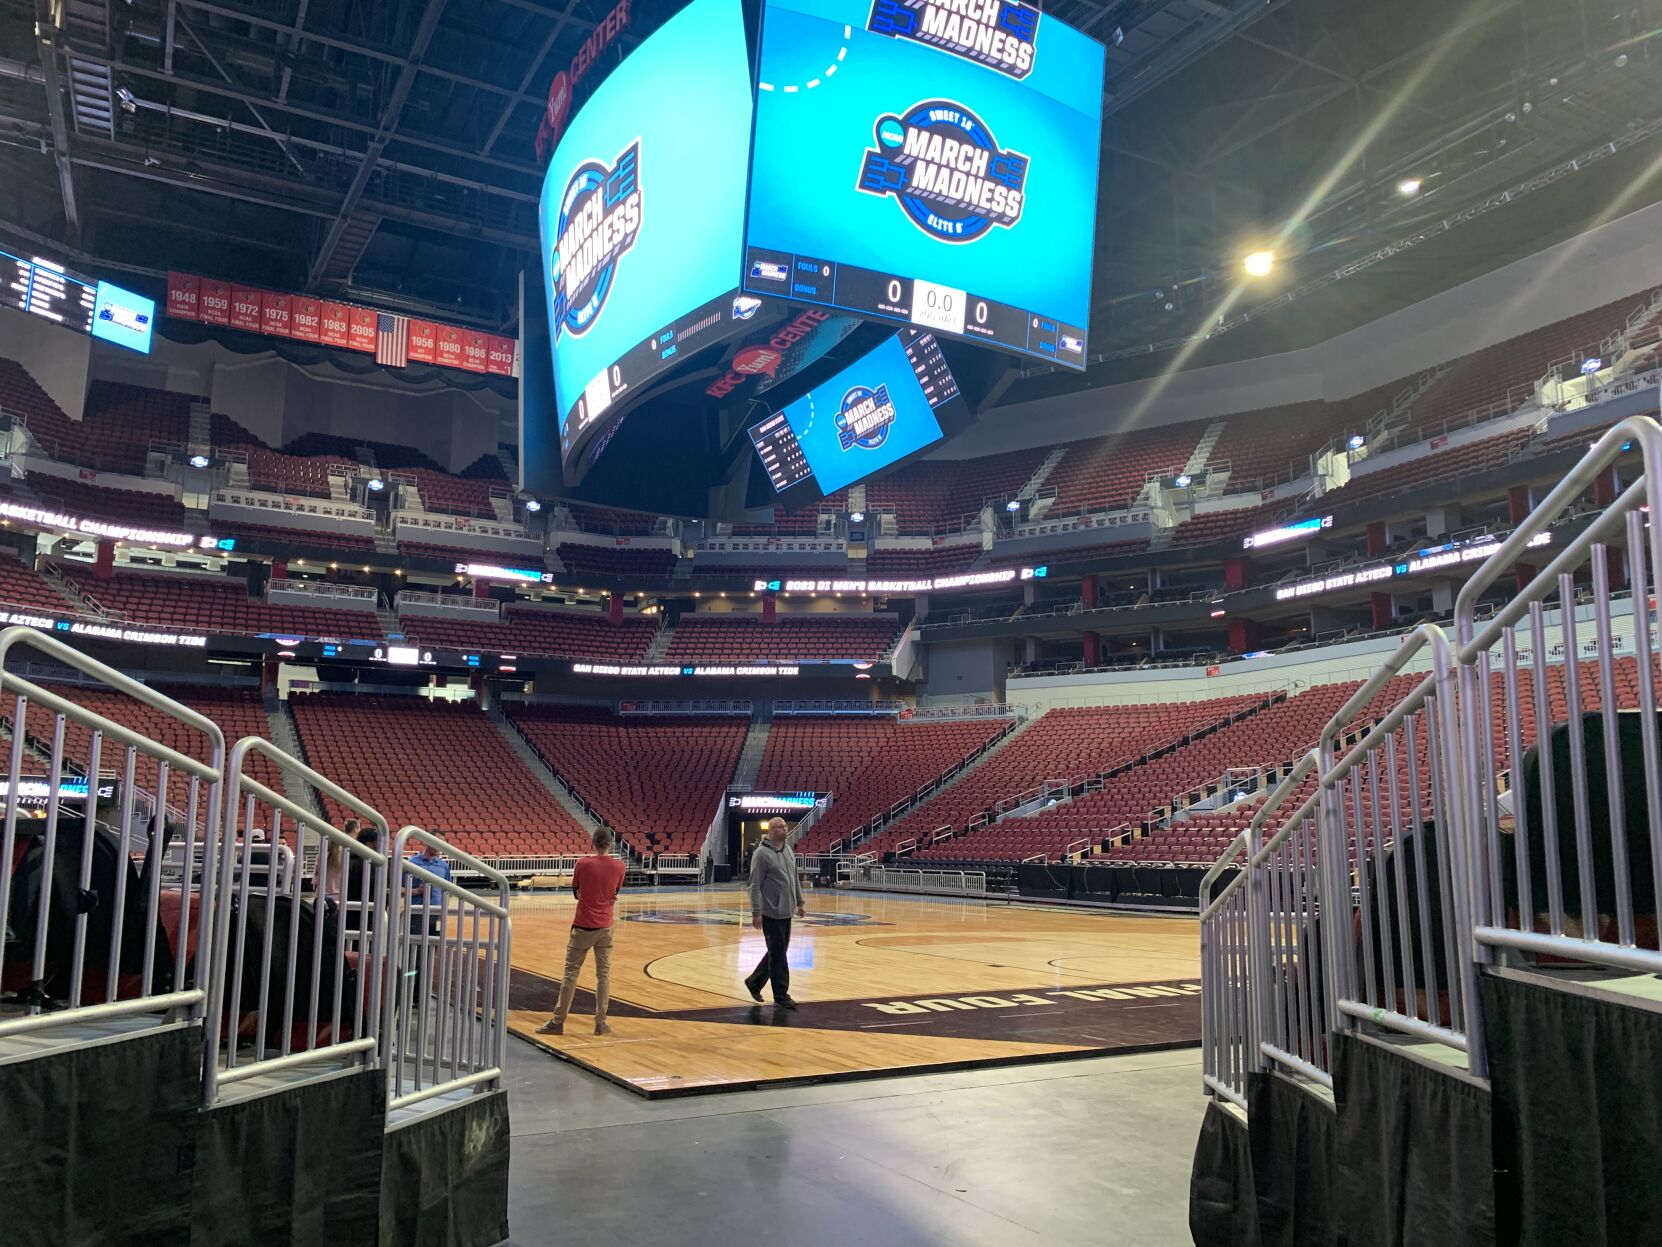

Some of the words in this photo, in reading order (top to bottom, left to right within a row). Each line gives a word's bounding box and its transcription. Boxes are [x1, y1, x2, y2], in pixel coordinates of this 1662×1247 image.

[922, 5, 1034, 70] MADNESS
[549, 74, 567, 122] Yum!
[570, 0, 632, 86] CENTER
[929, 110, 960, 123] SWEET
[904, 127, 989, 177] MARCH
[912, 160, 1021, 217] MADNESS
[559, 187, 603, 275] MARCH
[927, 213, 953, 233] ELITE
[566, 192, 640, 300] MADNESS
[798, 262, 818, 272] FOULS
[823, 266, 830, 276] 0
[170, 290, 196, 304] 1948
[794, 284, 816, 295] BONUS
[888, 280, 901, 302] 0
[203, 296, 228, 309] 1959
[234, 302, 259, 315] 1972
[926, 290, 953, 312] 0.0
[265, 308, 288, 321] 1975
[295, 314, 318, 327] 1982
[976, 302, 987, 323] 0
[324, 319, 346, 332] 1983
[351, 324, 375, 337] 2005
[1032, 318, 1038, 328] 0
[412, 336, 433, 348] 1956
[439, 341, 460, 353] 1980
[464, 346, 486, 358] 1986
[490, 351, 512, 363] 2013
[706, 370, 746, 398] KFC
[736, 350, 778, 373] Yum!
[770, 310, 830, 349] CENTE
[613, 365, 621, 386] 0
[579, 400, 585, 419] 0
[844, 397, 876, 425] MARCH
[853, 402, 894, 436] MADNESS
[80, 519, 194, 545] CHAMPIONSHIP
[786, 580, 815, 590] 2023
[833, 580, 865, 590] MEN'S
[868, 579, 932, 591] BASKETBALL
[935, 570, 1015, 589] CHAMPIONSHIP
[1277, 588, 1295, 600] SAN
[1296, 582, 1324, 596] DIEGO
[1325, 575, 1354, 589] STATE
[1355, 567, 1392, 583] AZTECS
[1396, 564, 1408, 575] VS
[1409, 551, 1460, 572] ALABAMA
[9, 614, 53, 629] AZTECS
[56, 622, 69, 631] VS
[71, 623, 121, 639] ALABAMA
[124, 631, 176, 644] CRIMSON
[179, 636, 206, 646] TIDE
[375, 648, 382, 658] 0
[424, 652, 431, 662] 0
[573, 664, 592, 673] SAN
[593, 665, 619, 674] DIEGO
[621, 666, 647, 675] STATE
[648, 667, 680, 675] AZTECS
[694, 667, 735, 675] ALABAMA
[736, 667, 777, 675] CRIMSON
[779, 667, 799, 675] TIDE
[861, 994, 1057, 1014] FOUR
